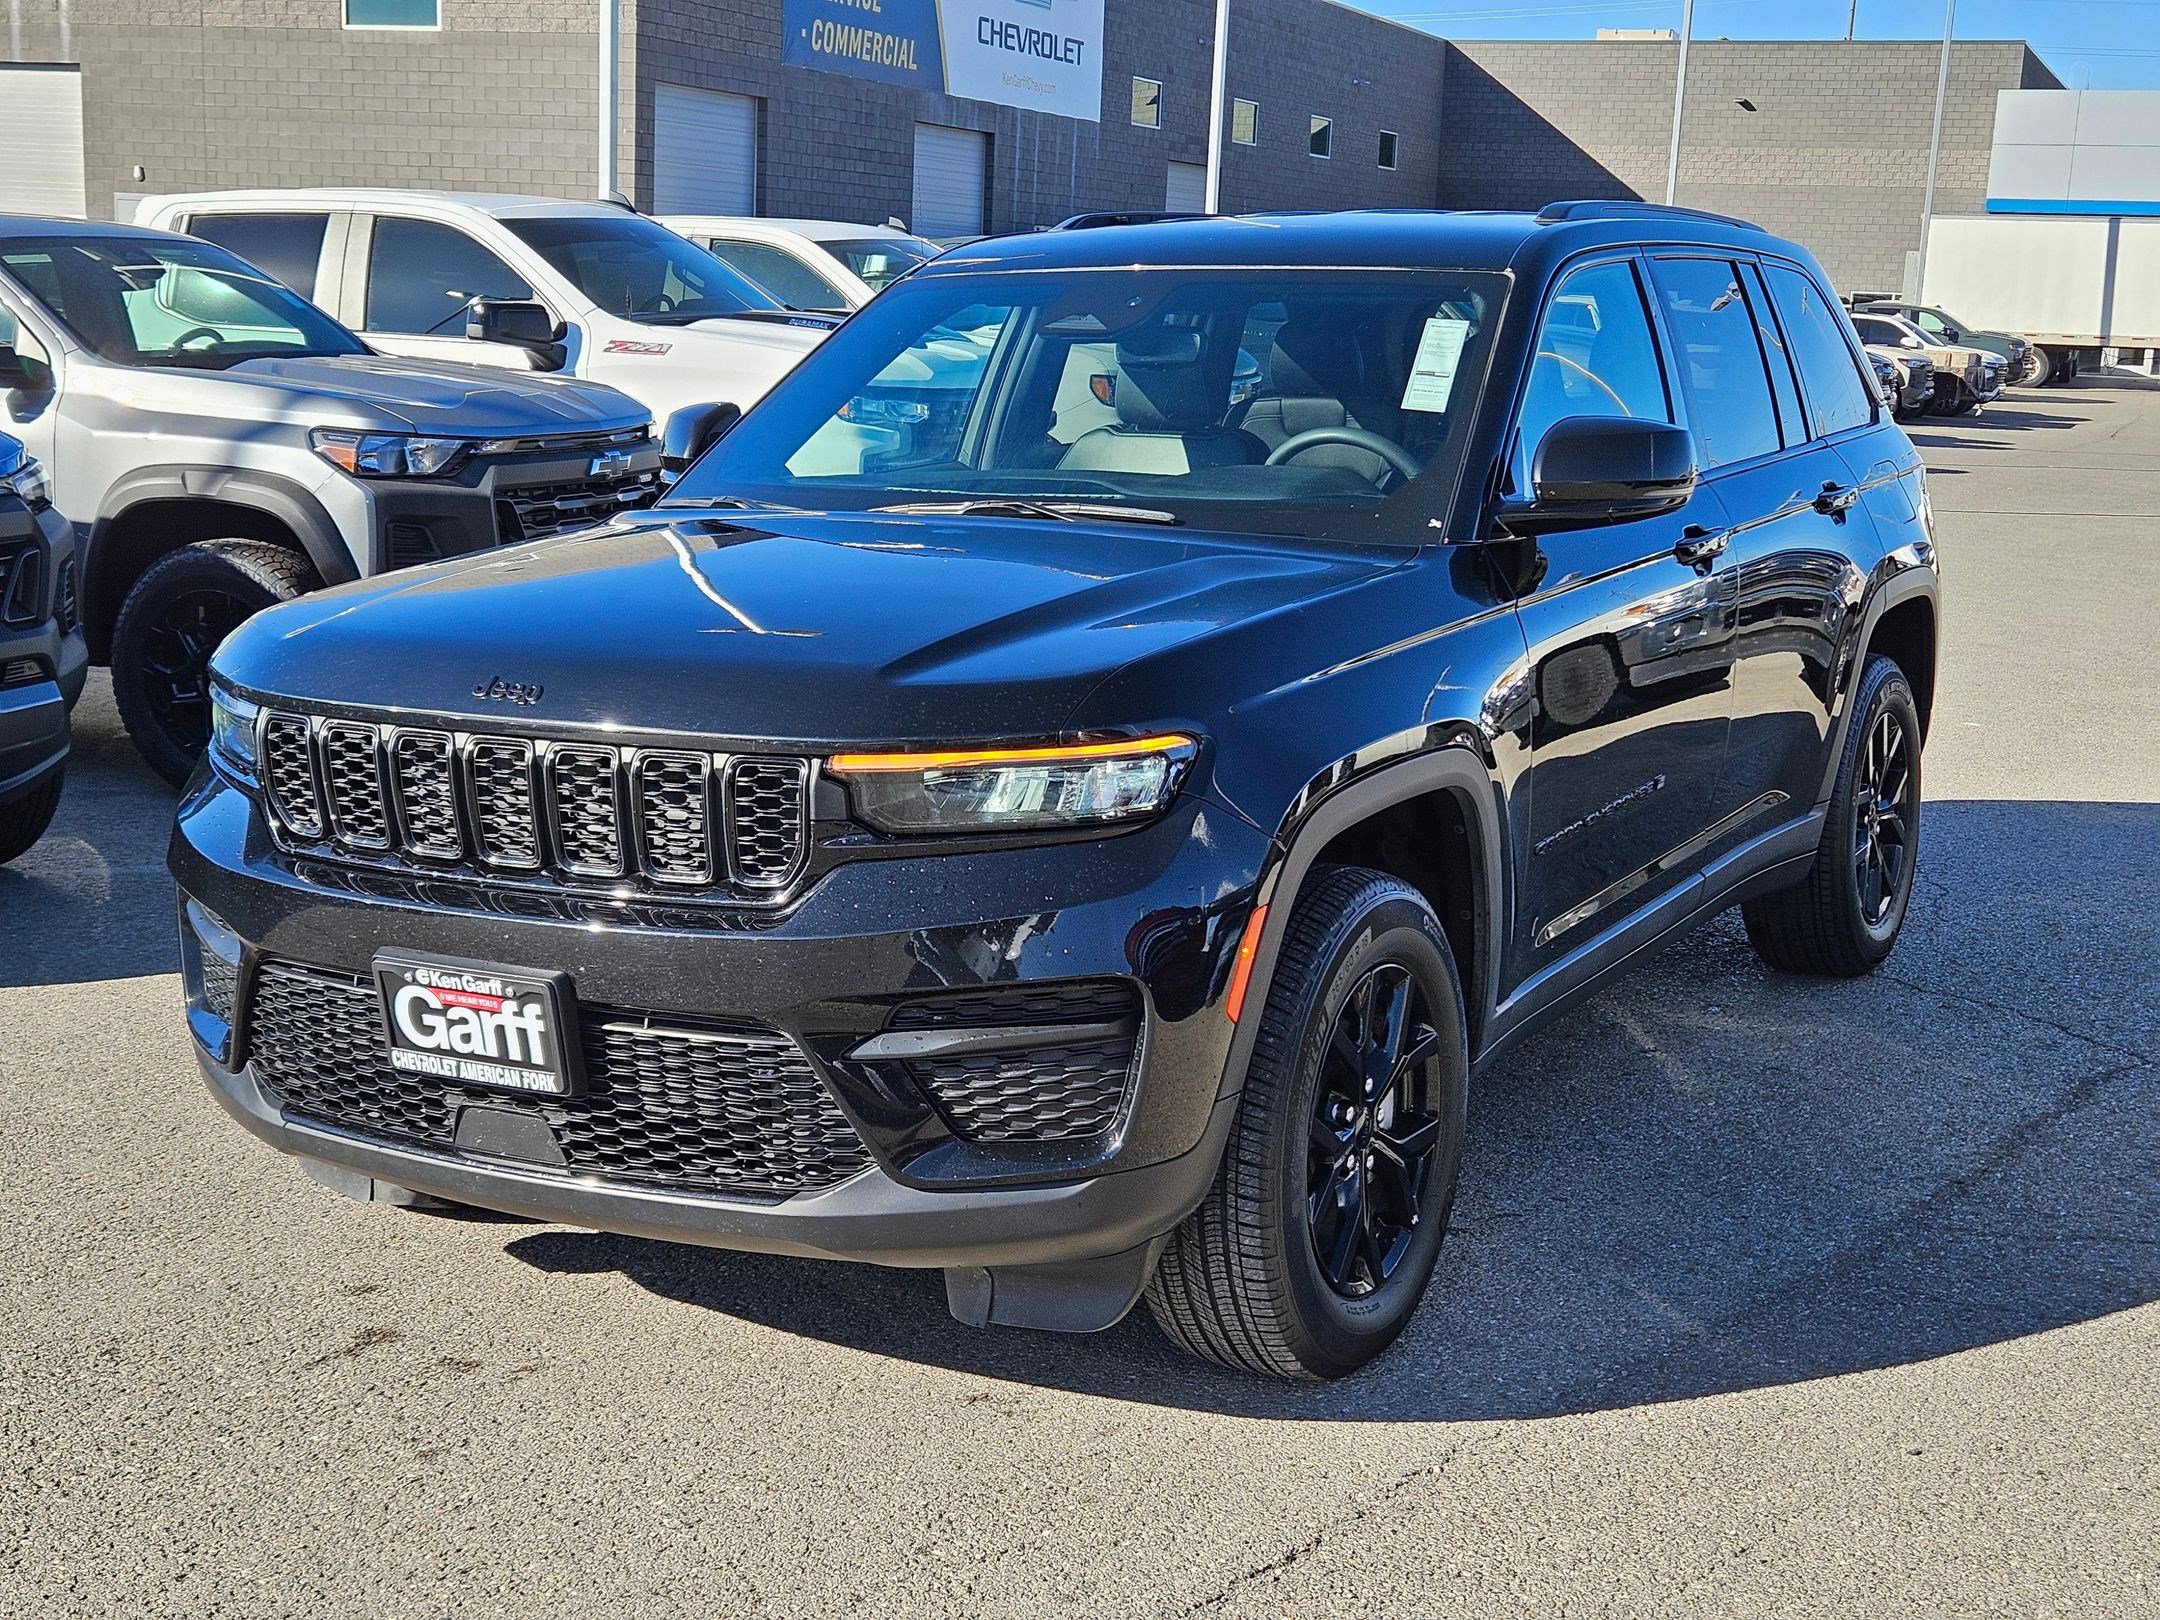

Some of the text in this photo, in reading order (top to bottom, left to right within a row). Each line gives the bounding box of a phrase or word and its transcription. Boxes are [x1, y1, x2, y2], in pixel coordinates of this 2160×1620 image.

[811, 18, 917, 71] COMMERCIAL
[977, 16, 1085, 66] CHEVROLET
[603, 339, 673, 356] Z71
[472, 675, 544, 708] Jeep
[428, 970, 502, 996] Ken Garff
[394, 984, 545, 1066] Garff
[391, 1049, 559, 1093] CHEVROLET AMERICAN FORK
